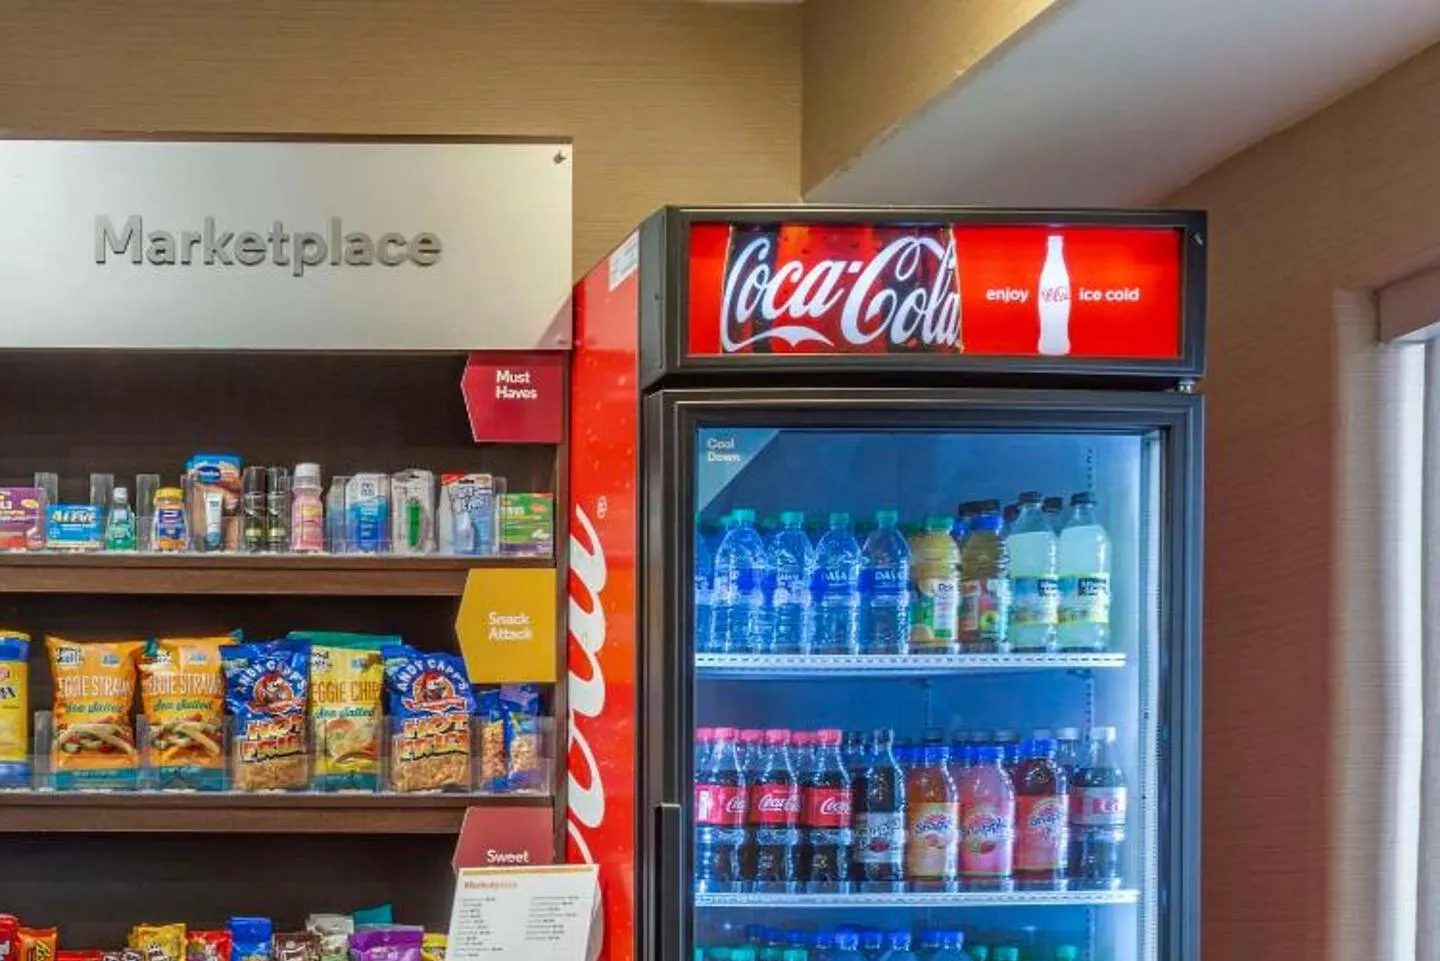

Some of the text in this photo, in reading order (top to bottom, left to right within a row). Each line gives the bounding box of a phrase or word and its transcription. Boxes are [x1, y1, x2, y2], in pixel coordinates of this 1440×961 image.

[94, 214, 444, 277] Marketplace
[721, 236, 961, 352] Coca-Cola
[986, 287, 1030, 303] enjoy
[1079, 287, 1103, 301] ice
[1105, 287, 1140, 301] cold
[496, 369, 530, 383] Must
[496, 385, 538, 399] Haves
[707, 437, 735, 449] Cool
[708, 451, 740, 461] Down
[488, 612, 530, 625] Snack
[489, 627, 533, 641] Attack
[312, 680, 345, 704] EGGIE
[486, 850, 530, 864] Sweet
